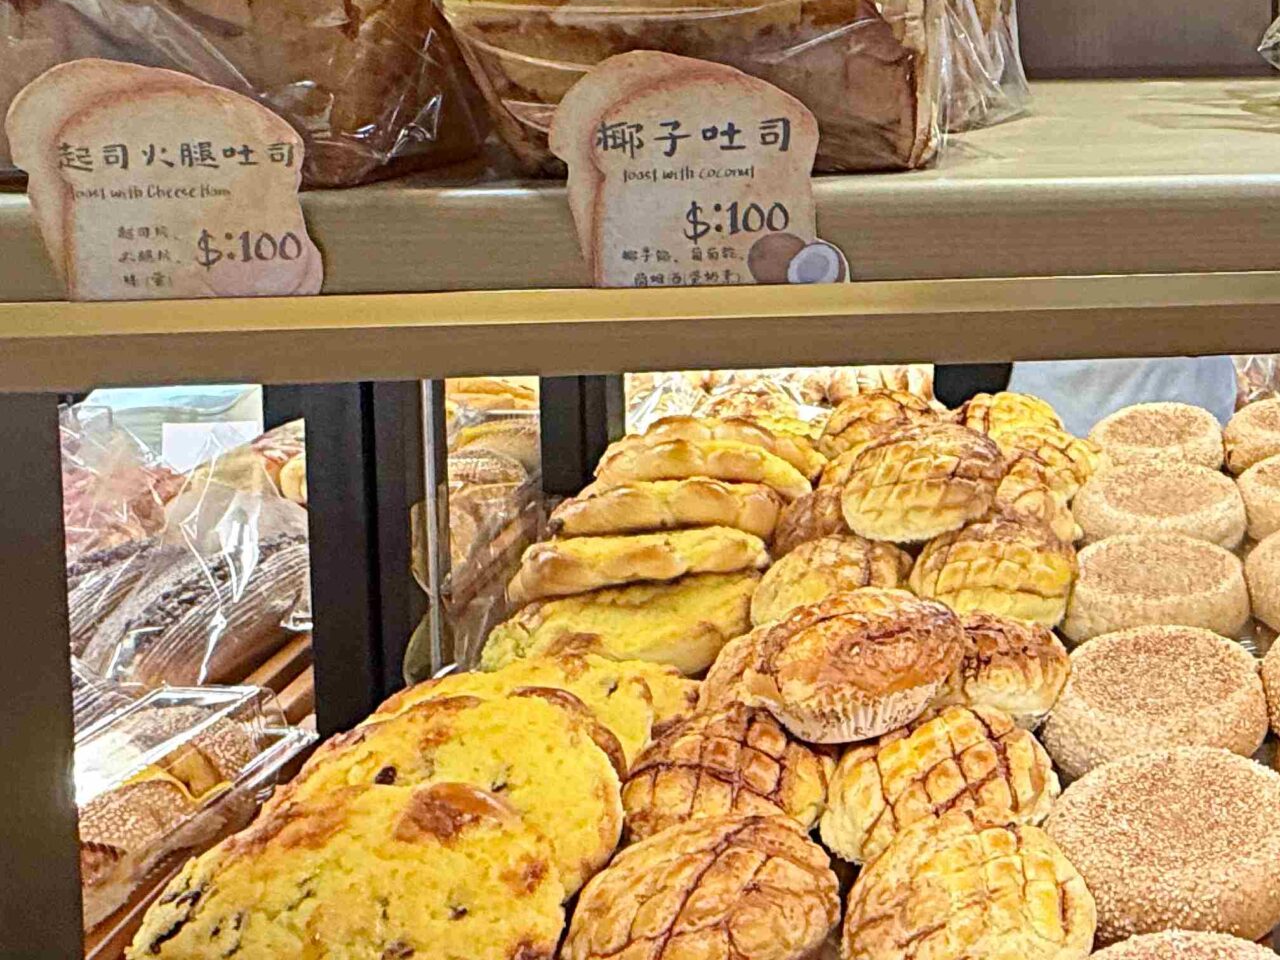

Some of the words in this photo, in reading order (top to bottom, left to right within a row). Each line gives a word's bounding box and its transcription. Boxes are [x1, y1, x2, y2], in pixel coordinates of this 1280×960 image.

[58, 141, 295, 173] 起司火腿吐司
[595, 116, 792, 160] 椰子吐司
[662, 166, 694, 181] with
[699, 165, 755, 179] coconut
[683, 200, 790, 245] $:100
[194, 229, 303, 271] $:100
